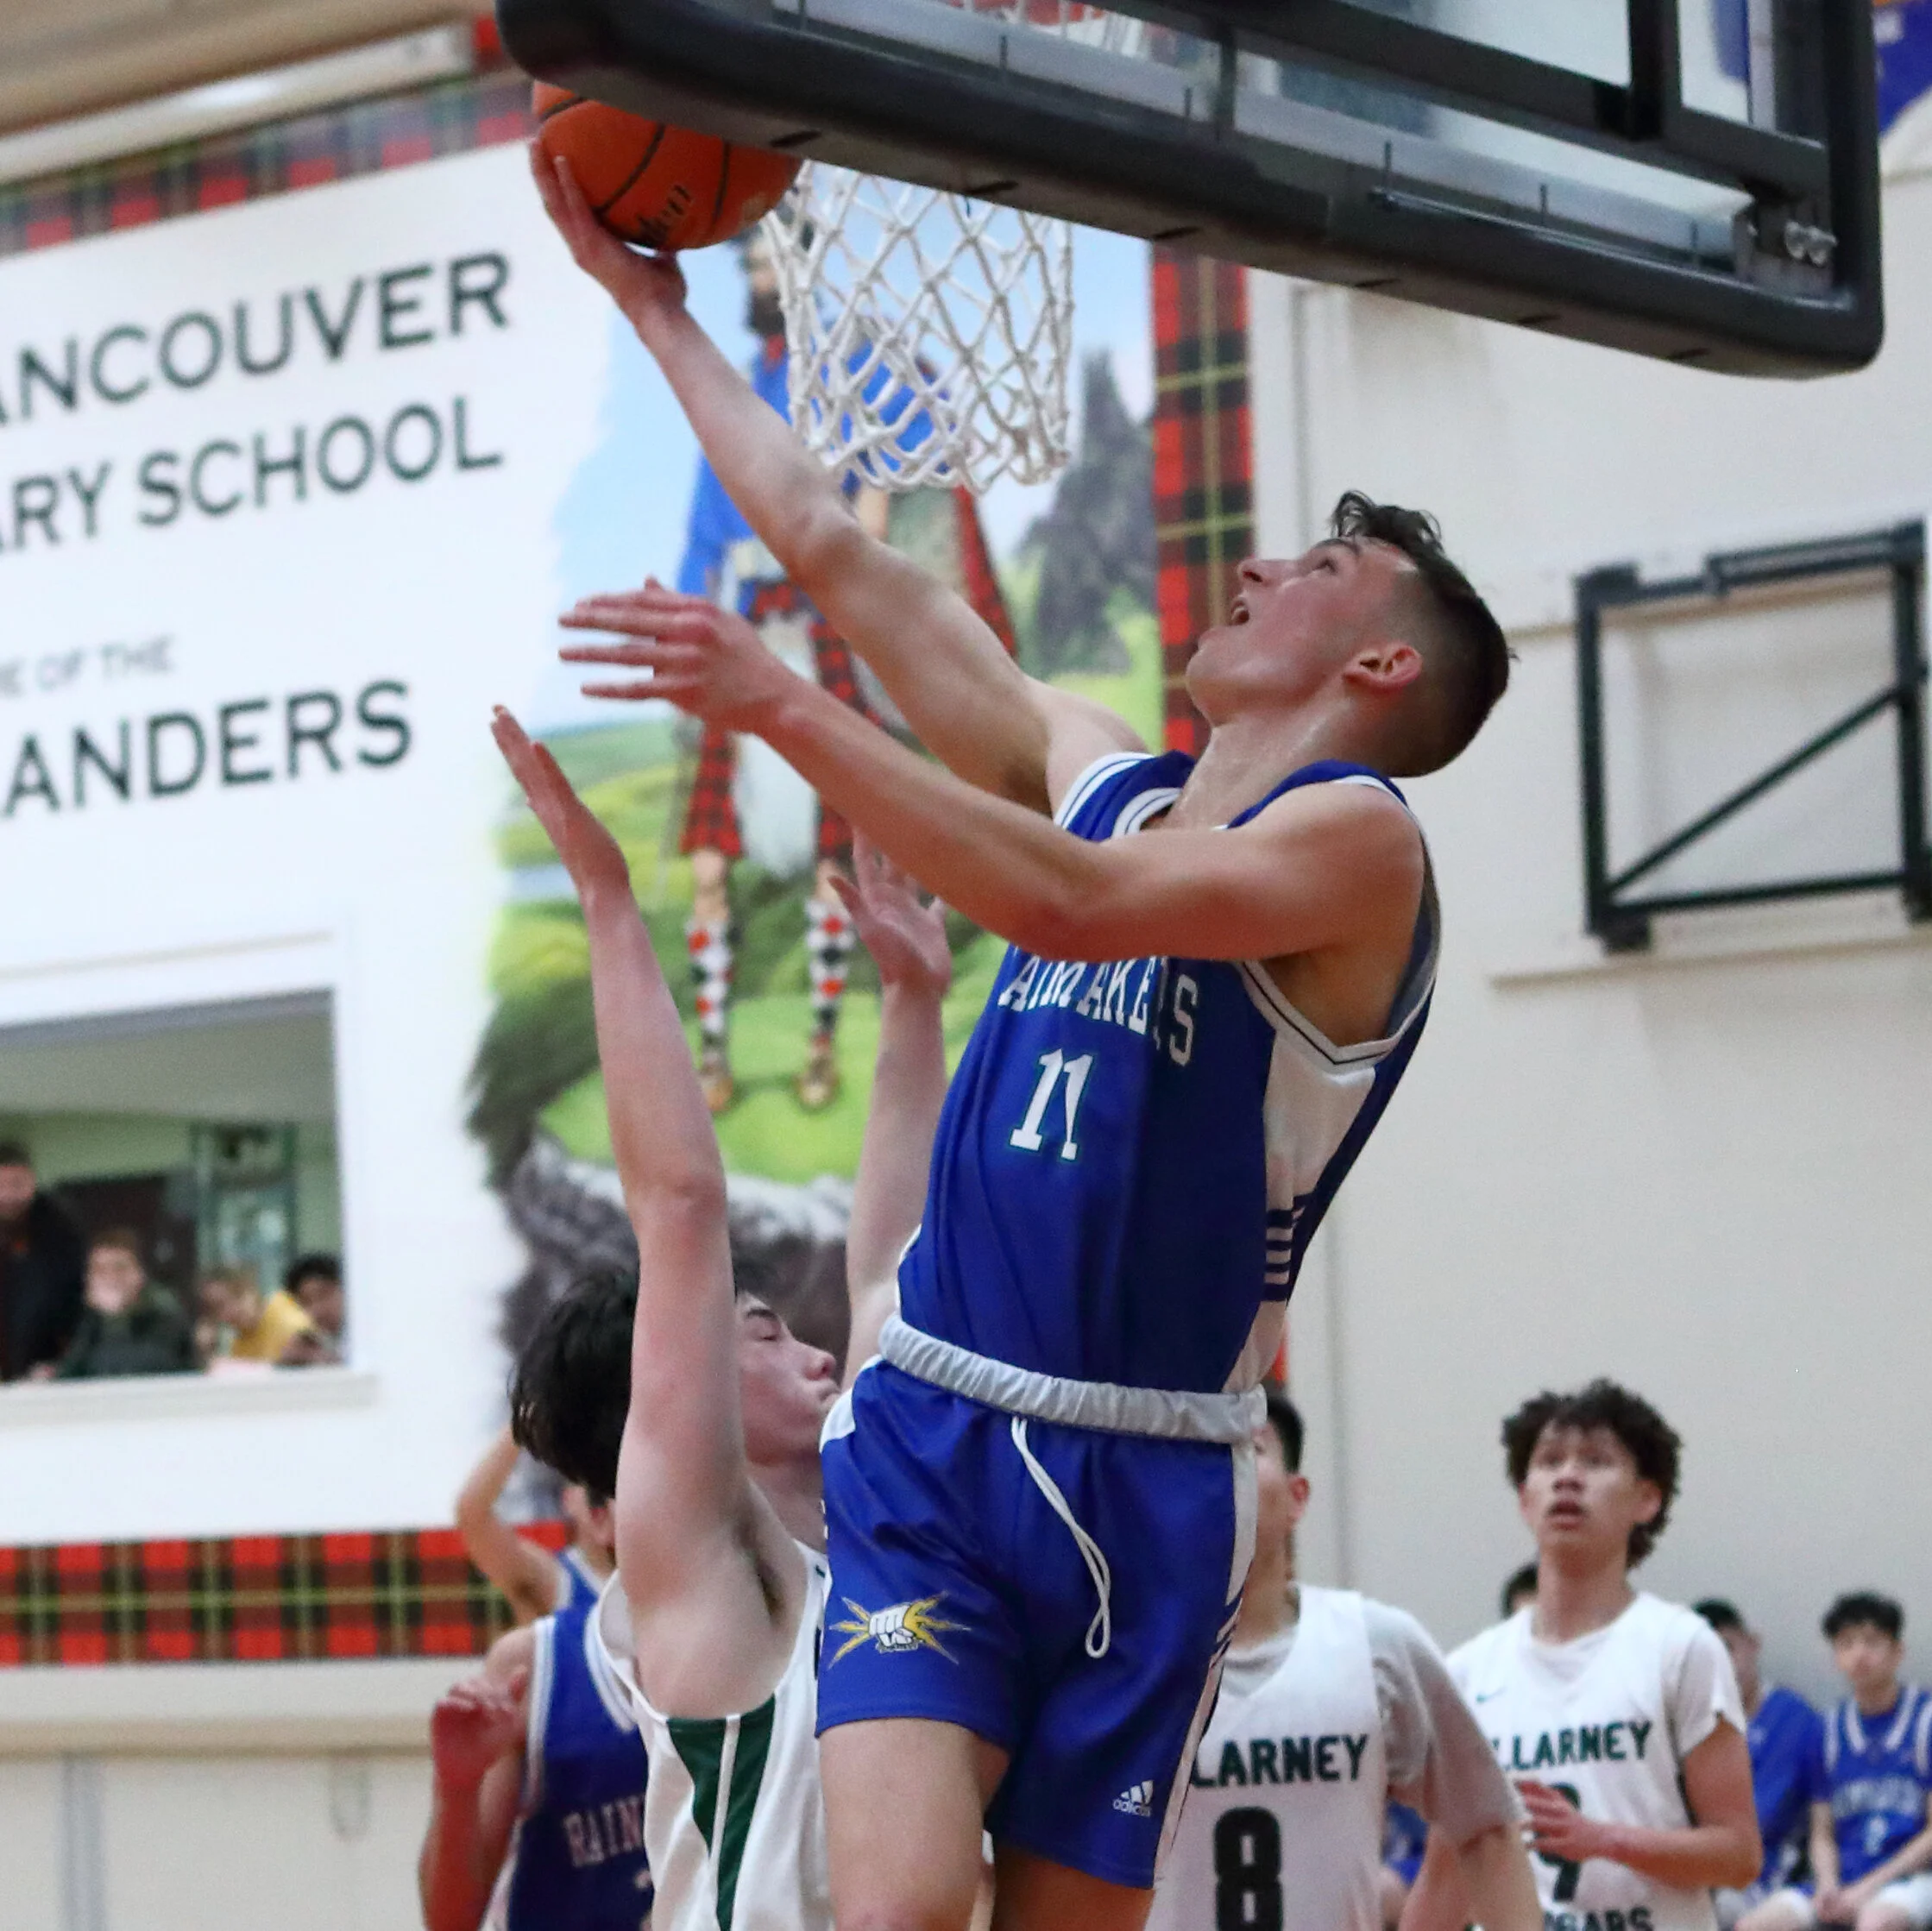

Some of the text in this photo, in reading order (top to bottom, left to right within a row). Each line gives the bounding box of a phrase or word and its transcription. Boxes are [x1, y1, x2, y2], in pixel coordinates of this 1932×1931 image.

[0, 252, 511, 426] NCOUVER
[0, 394, 505, 554] RY SCHOOL
[100, 634, 175, 683] THE
[2, 679, 412, 818] ANDERS
[1010, 1048, 1093, 1160] 11
[1493, 1719, 1653, 1770] LARNEY
[1213, 1806, 1284, 1931] 8
